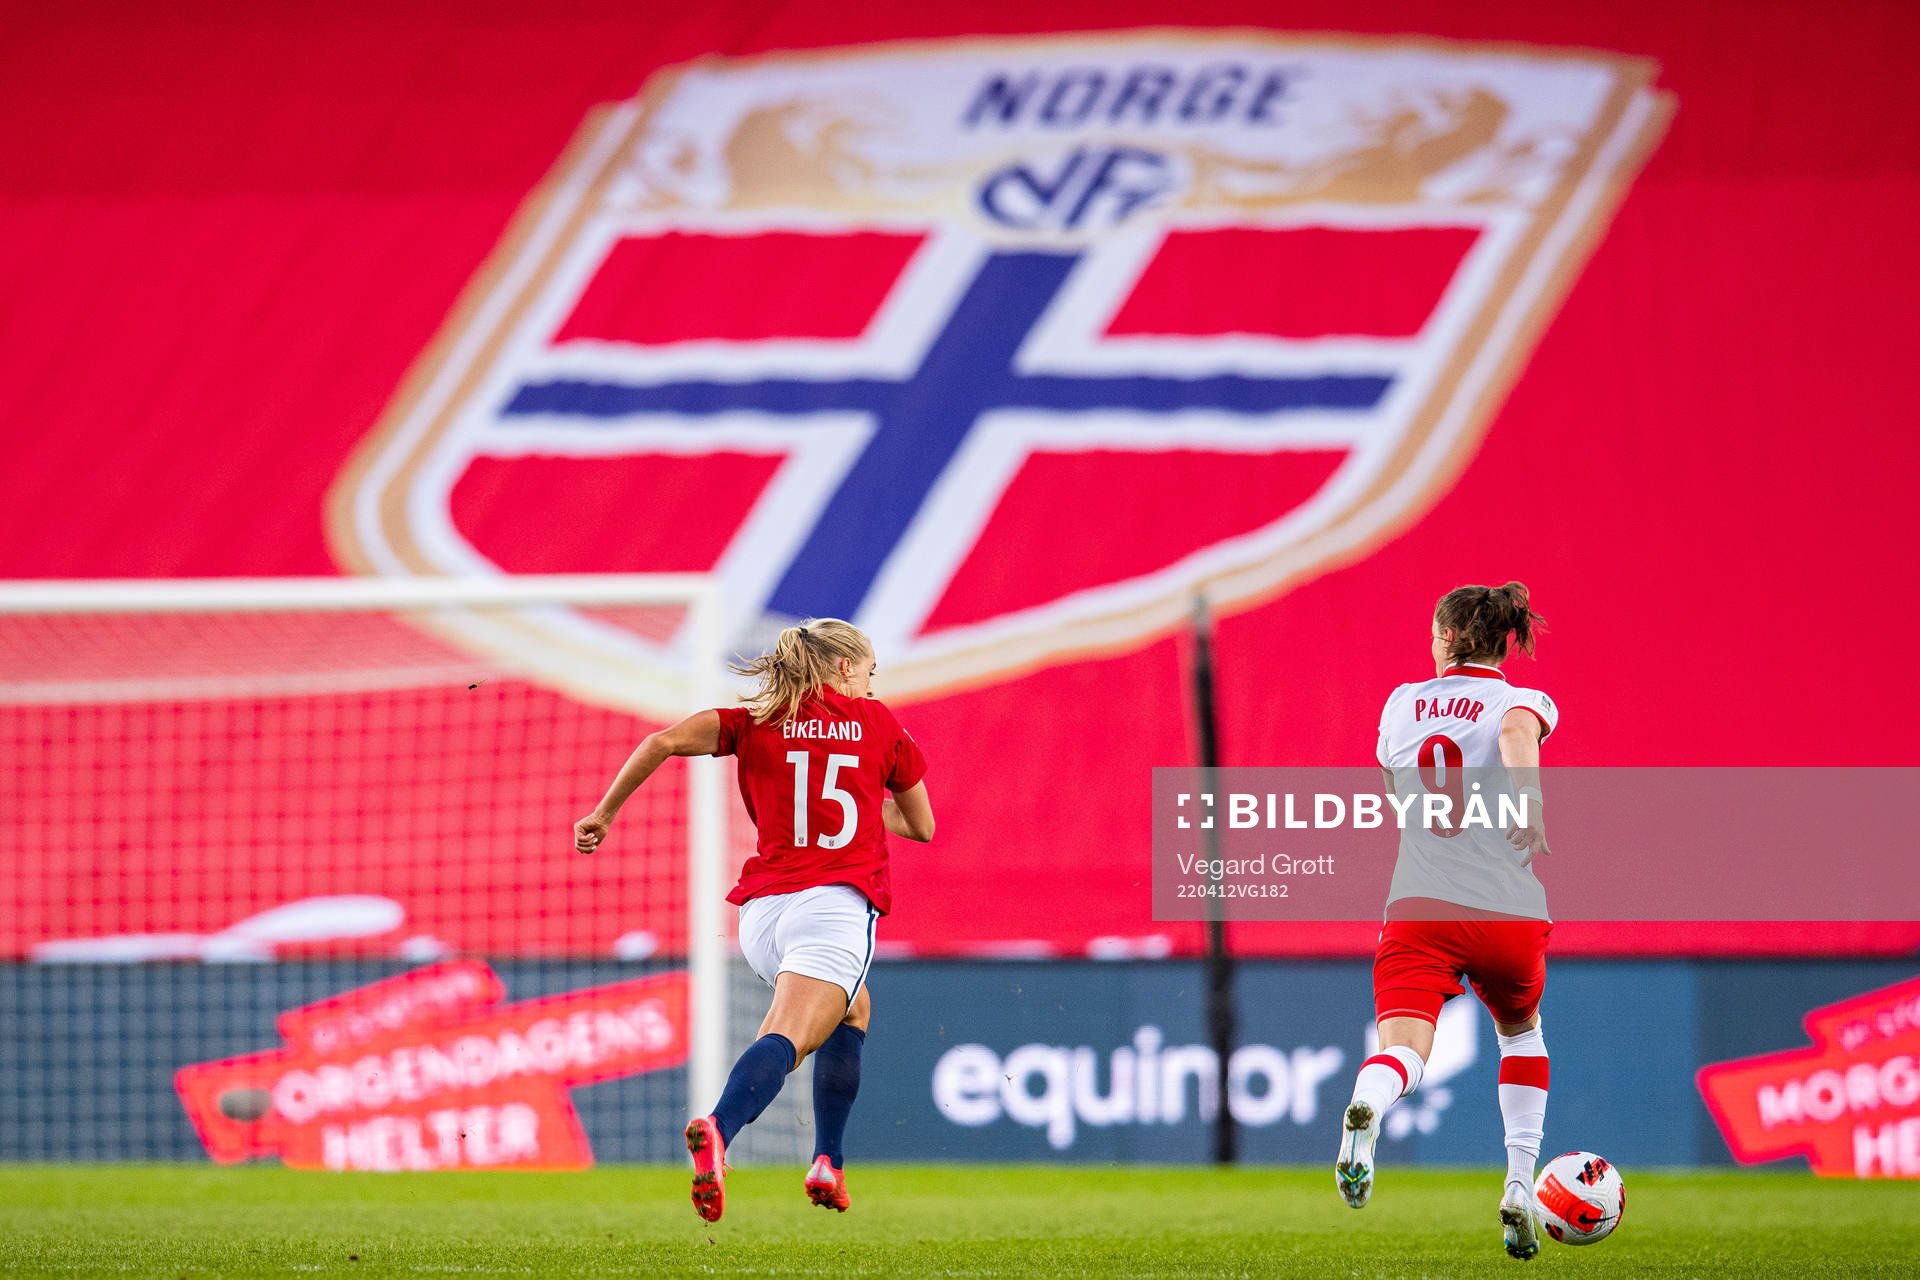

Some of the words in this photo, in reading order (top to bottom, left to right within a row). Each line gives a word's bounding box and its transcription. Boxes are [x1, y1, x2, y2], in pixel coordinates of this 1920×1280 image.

[963, 58, 1303, 130] NORGE
[783, 718, 862, 742] EIKELAND
[1415, 697, 1485, 723] PAJOR
[785, 750, 860, 850] 15
[1417, 734, 1466, 839] 9
[271, 998, 674, 1125] ORGENDAGENS
[932, 1025, 1344, 1150] equinor
